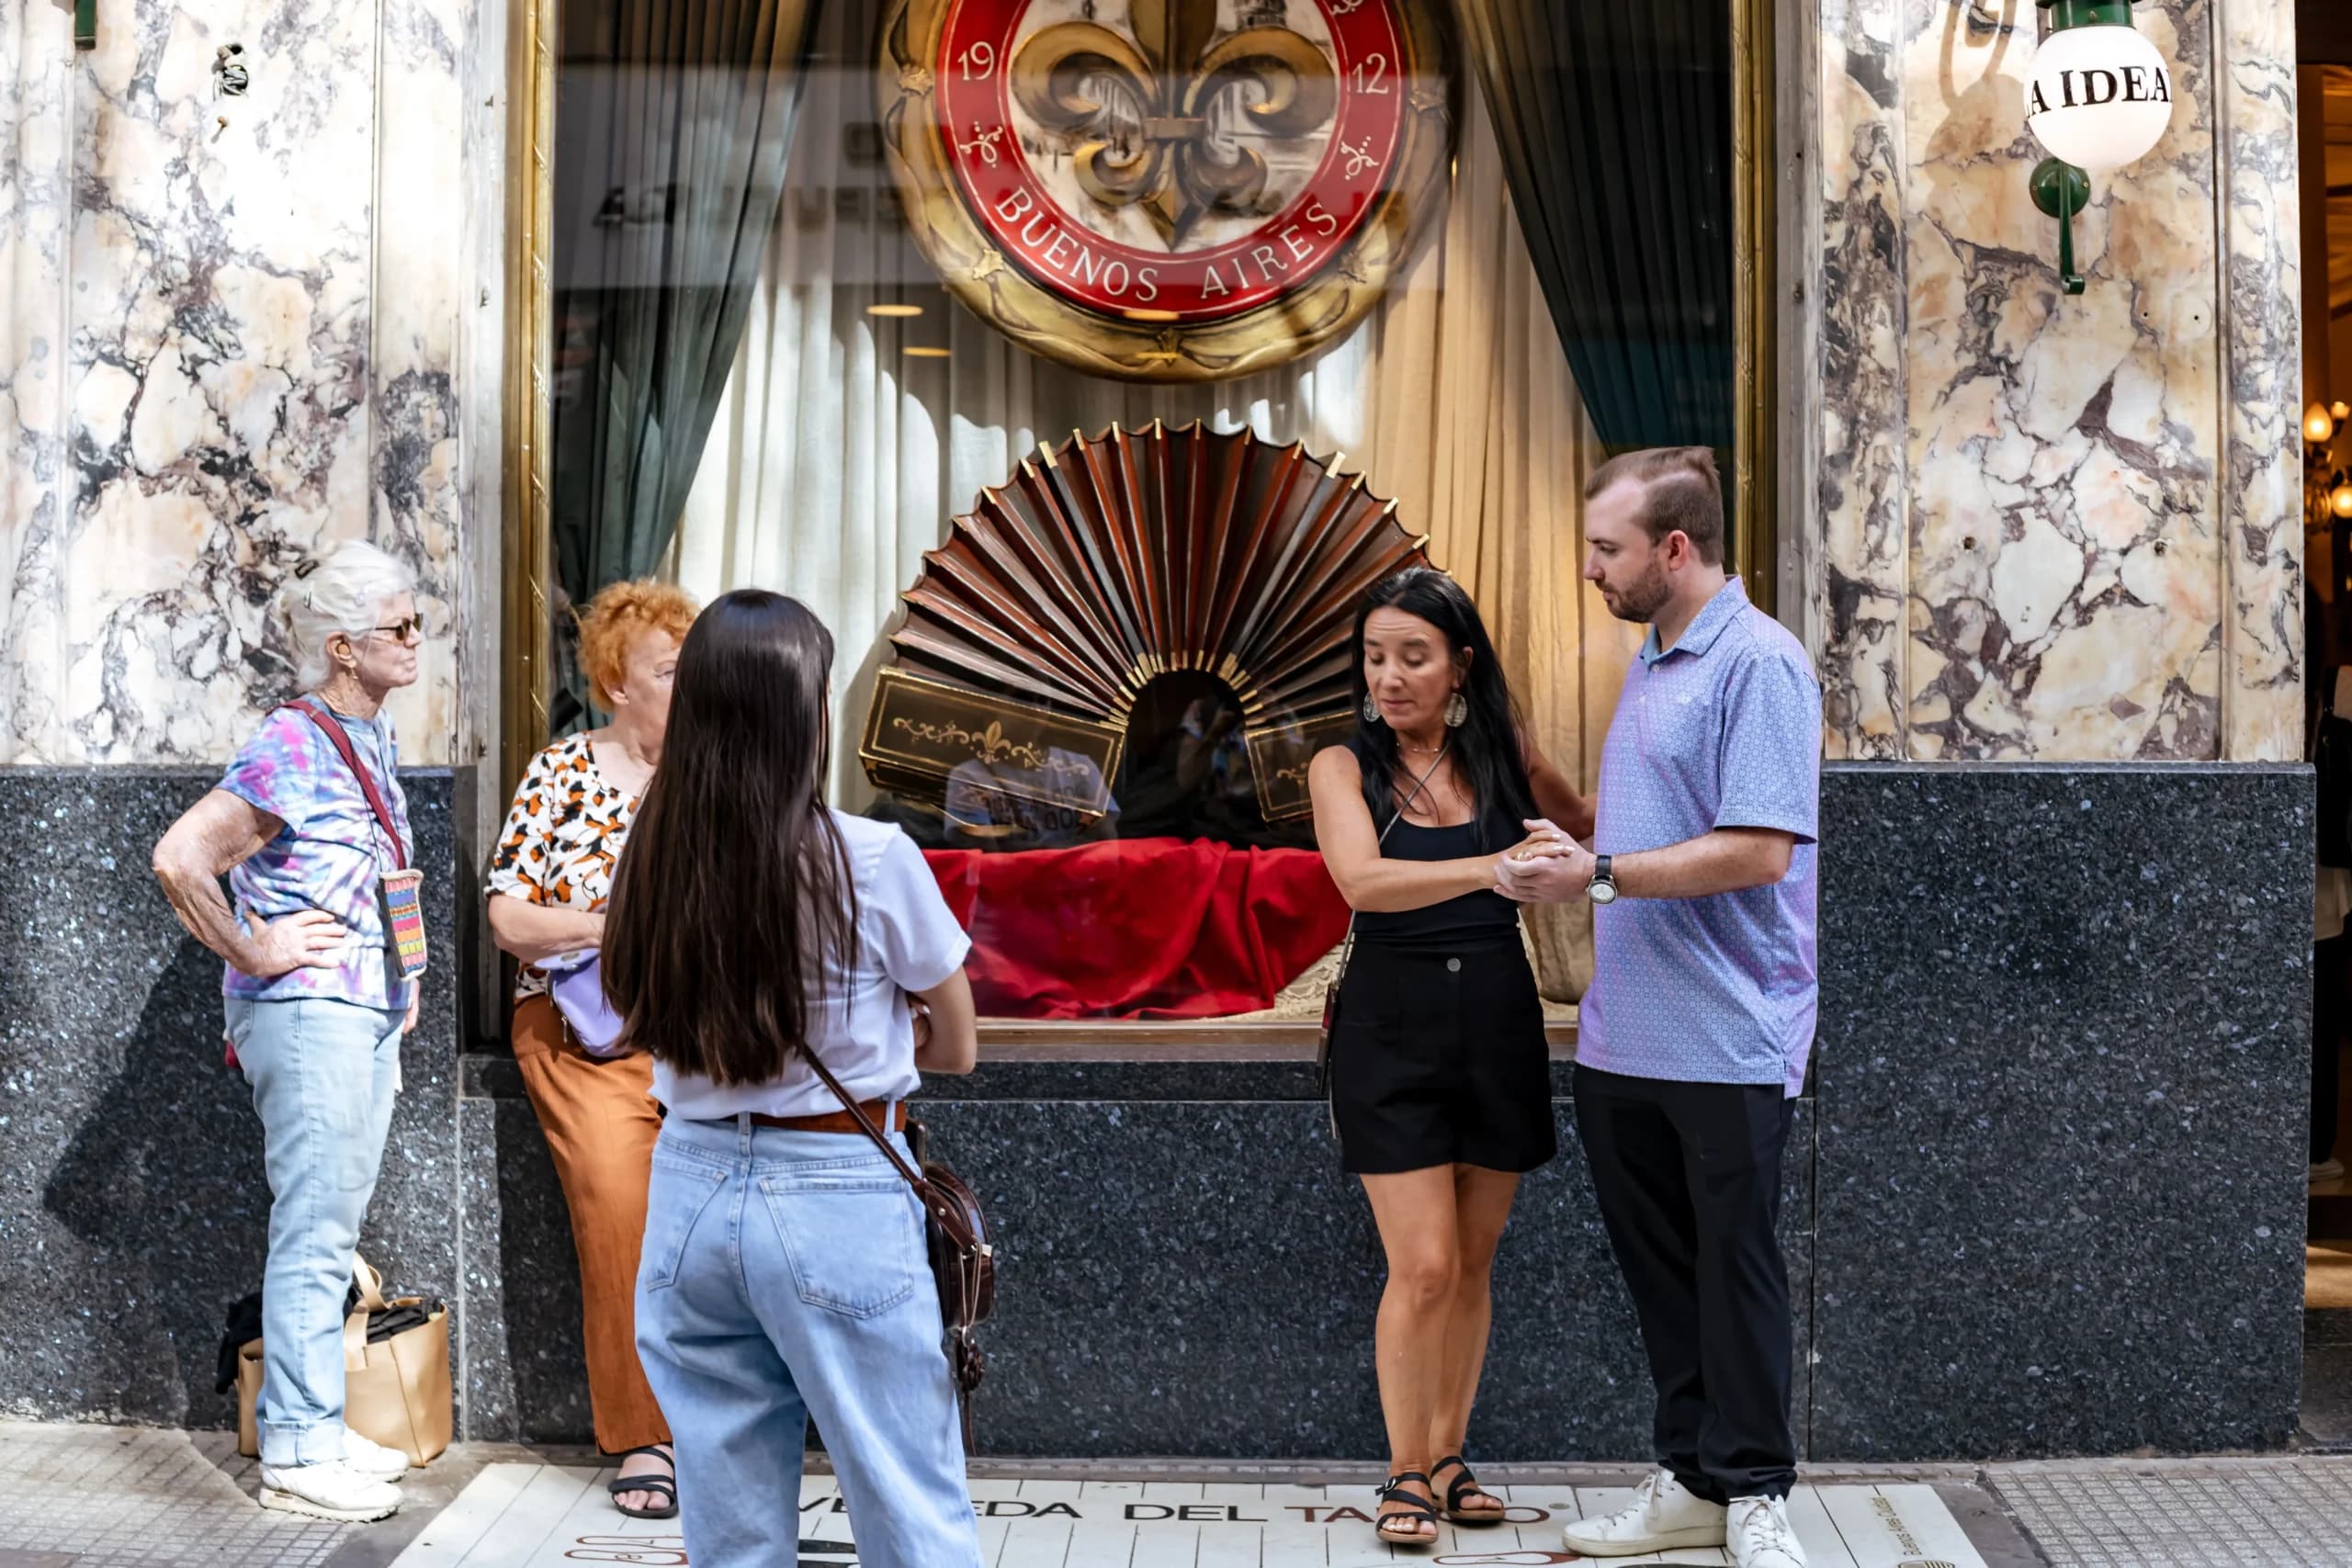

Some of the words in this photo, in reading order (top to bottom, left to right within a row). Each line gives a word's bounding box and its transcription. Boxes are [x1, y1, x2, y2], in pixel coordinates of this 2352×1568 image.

[956, 40, 995, 83] 19
[1351, 52, 1389, 95] 12
[2027, 80, 2052, 118] A
[2059, 65, 2173, 108] IDEA
[994, 186, 1159, 302] BUENOS
[1200, 201, 1339, 300] AIRES
[1124, 1504, 1268, 1522] DEL
[1283, 1506, 1550, 1524] TAO
